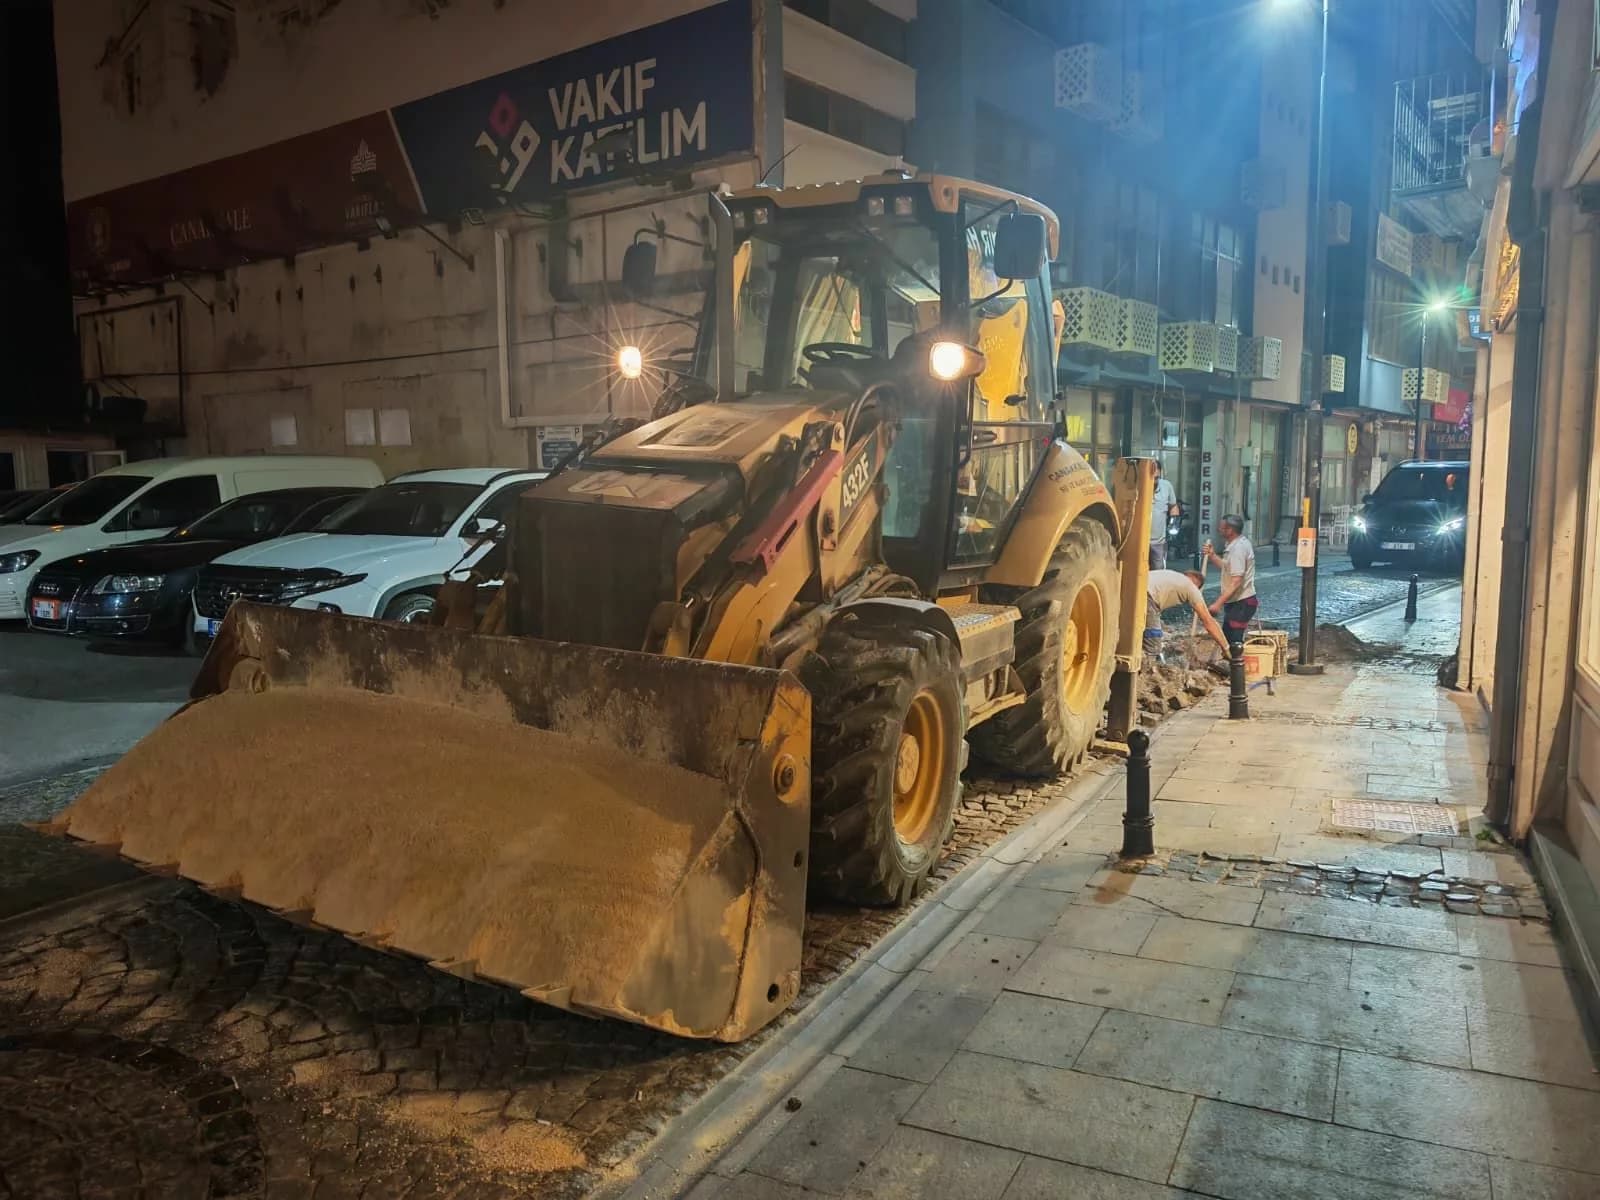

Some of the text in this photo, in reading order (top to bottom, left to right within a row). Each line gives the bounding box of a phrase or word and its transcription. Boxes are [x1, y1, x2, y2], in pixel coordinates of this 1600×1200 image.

[548, 58, 657, 131] VAKIF
[843, 452, 869, 507] 432F
[1201, 452, 1212, 534] BERBER
